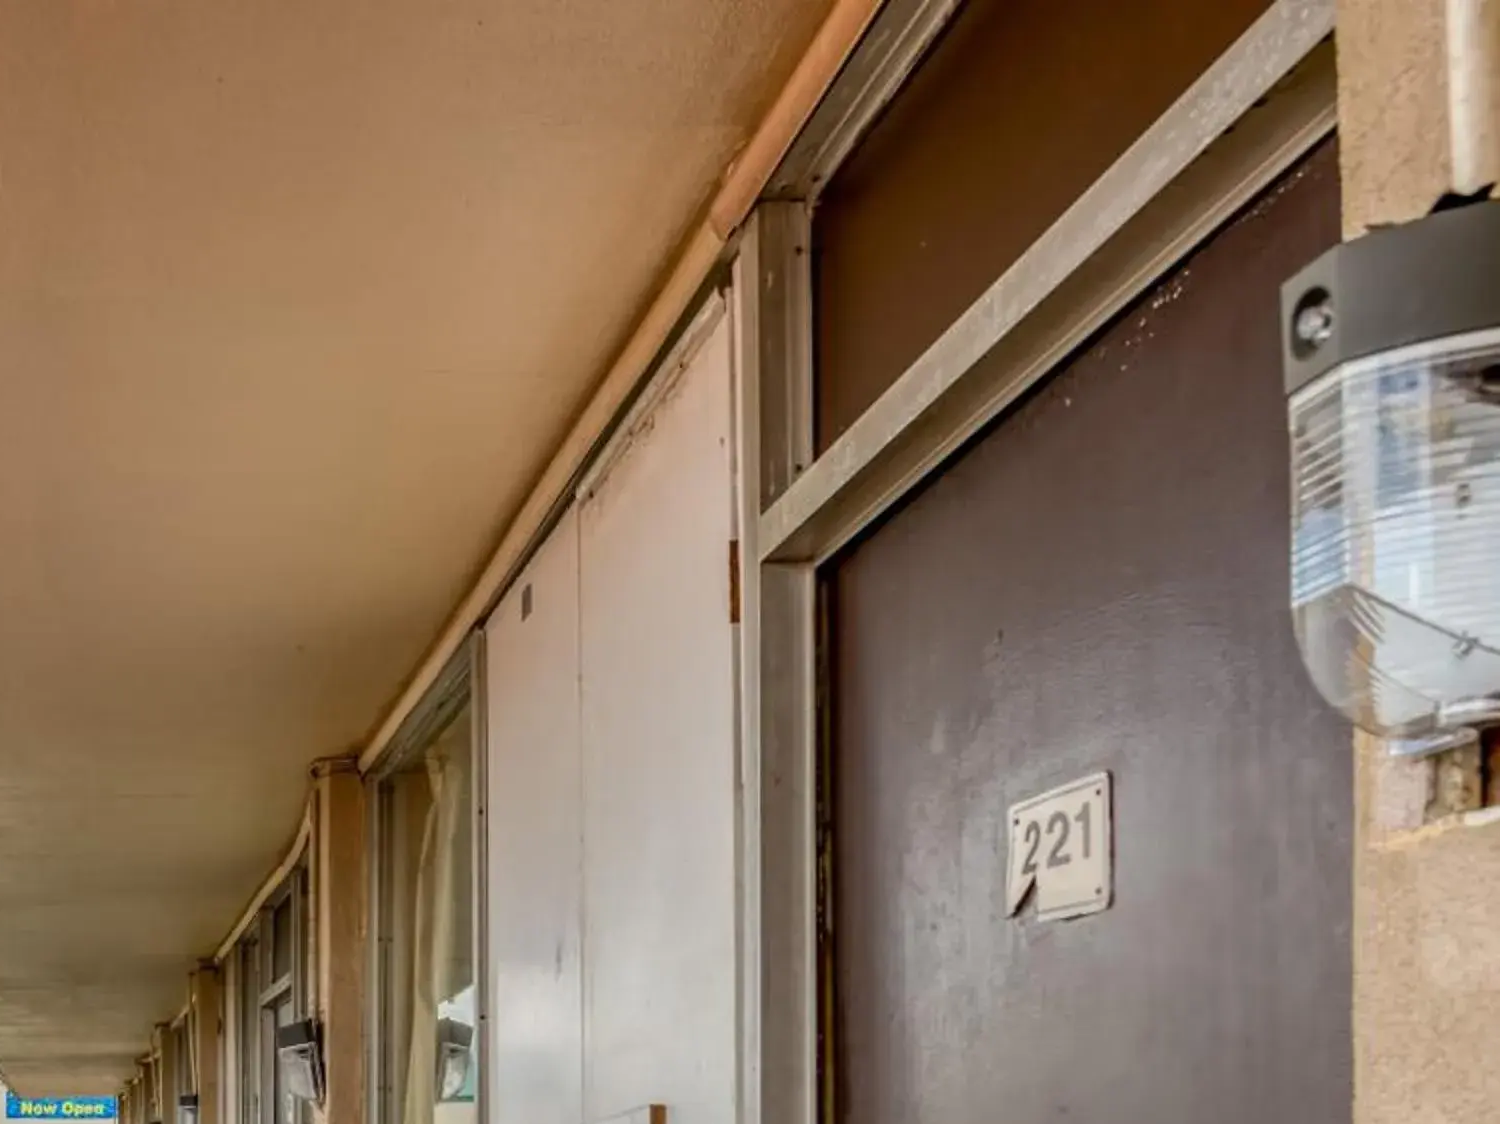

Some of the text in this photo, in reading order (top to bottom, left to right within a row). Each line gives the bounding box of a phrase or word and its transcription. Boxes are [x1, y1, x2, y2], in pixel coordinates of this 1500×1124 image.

[1021, 801, 1091, 876] 221
[20, 1099, 106, 1117] Now Open
